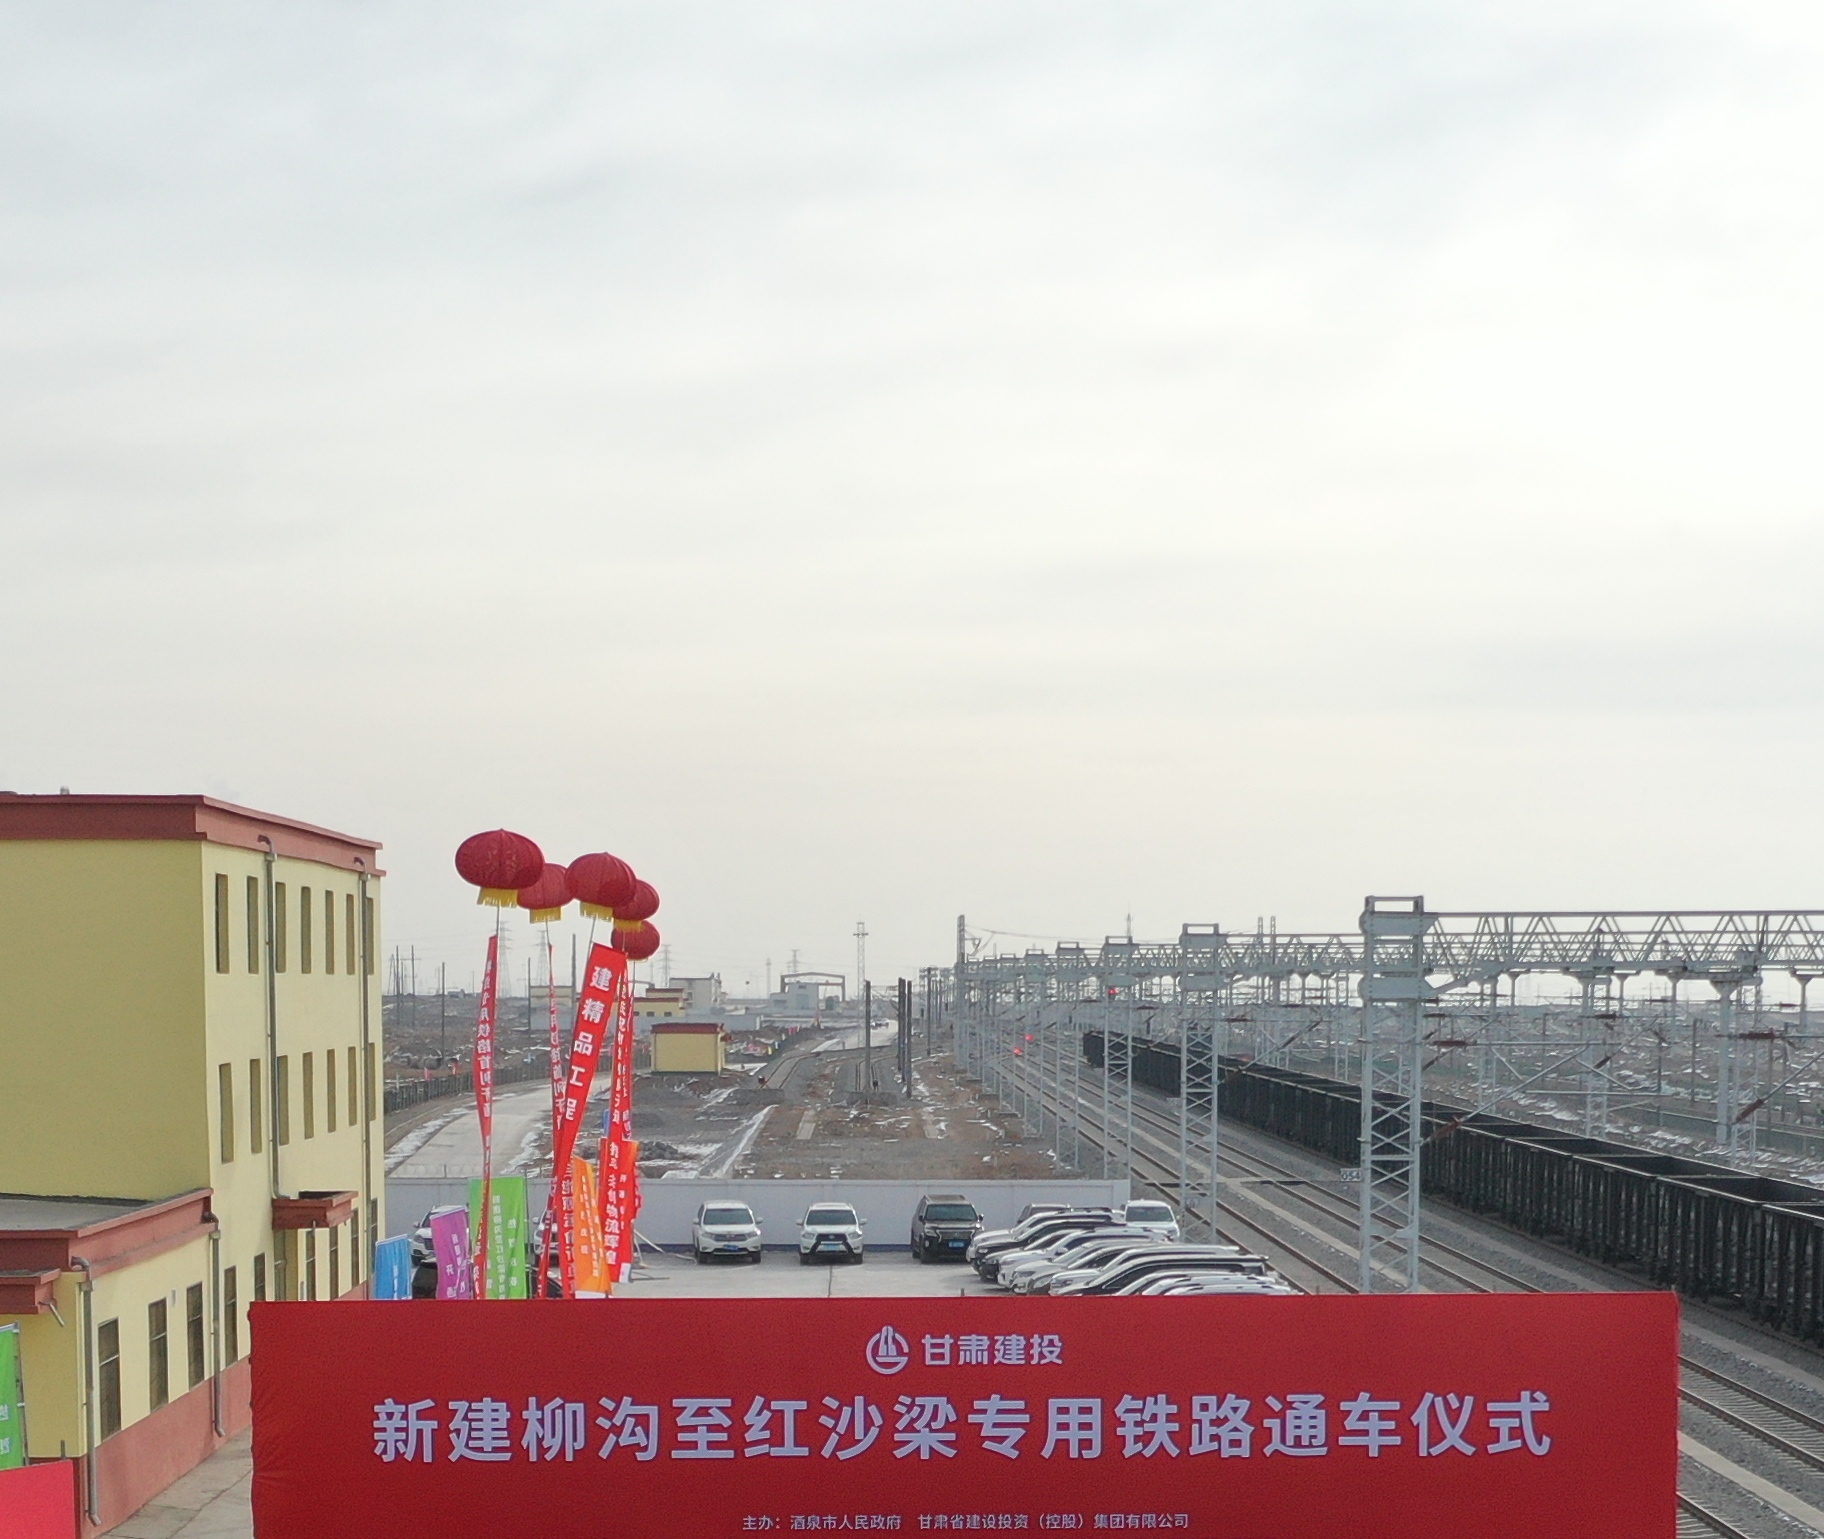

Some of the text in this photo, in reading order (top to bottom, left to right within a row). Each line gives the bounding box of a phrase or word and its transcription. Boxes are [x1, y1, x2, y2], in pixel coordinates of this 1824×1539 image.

[921, 1332, 1064, 1366] 甘肃建投
[373, 1391, 1551, 1463] 新建柳沟至红沙梁专用铁路通车仪式
